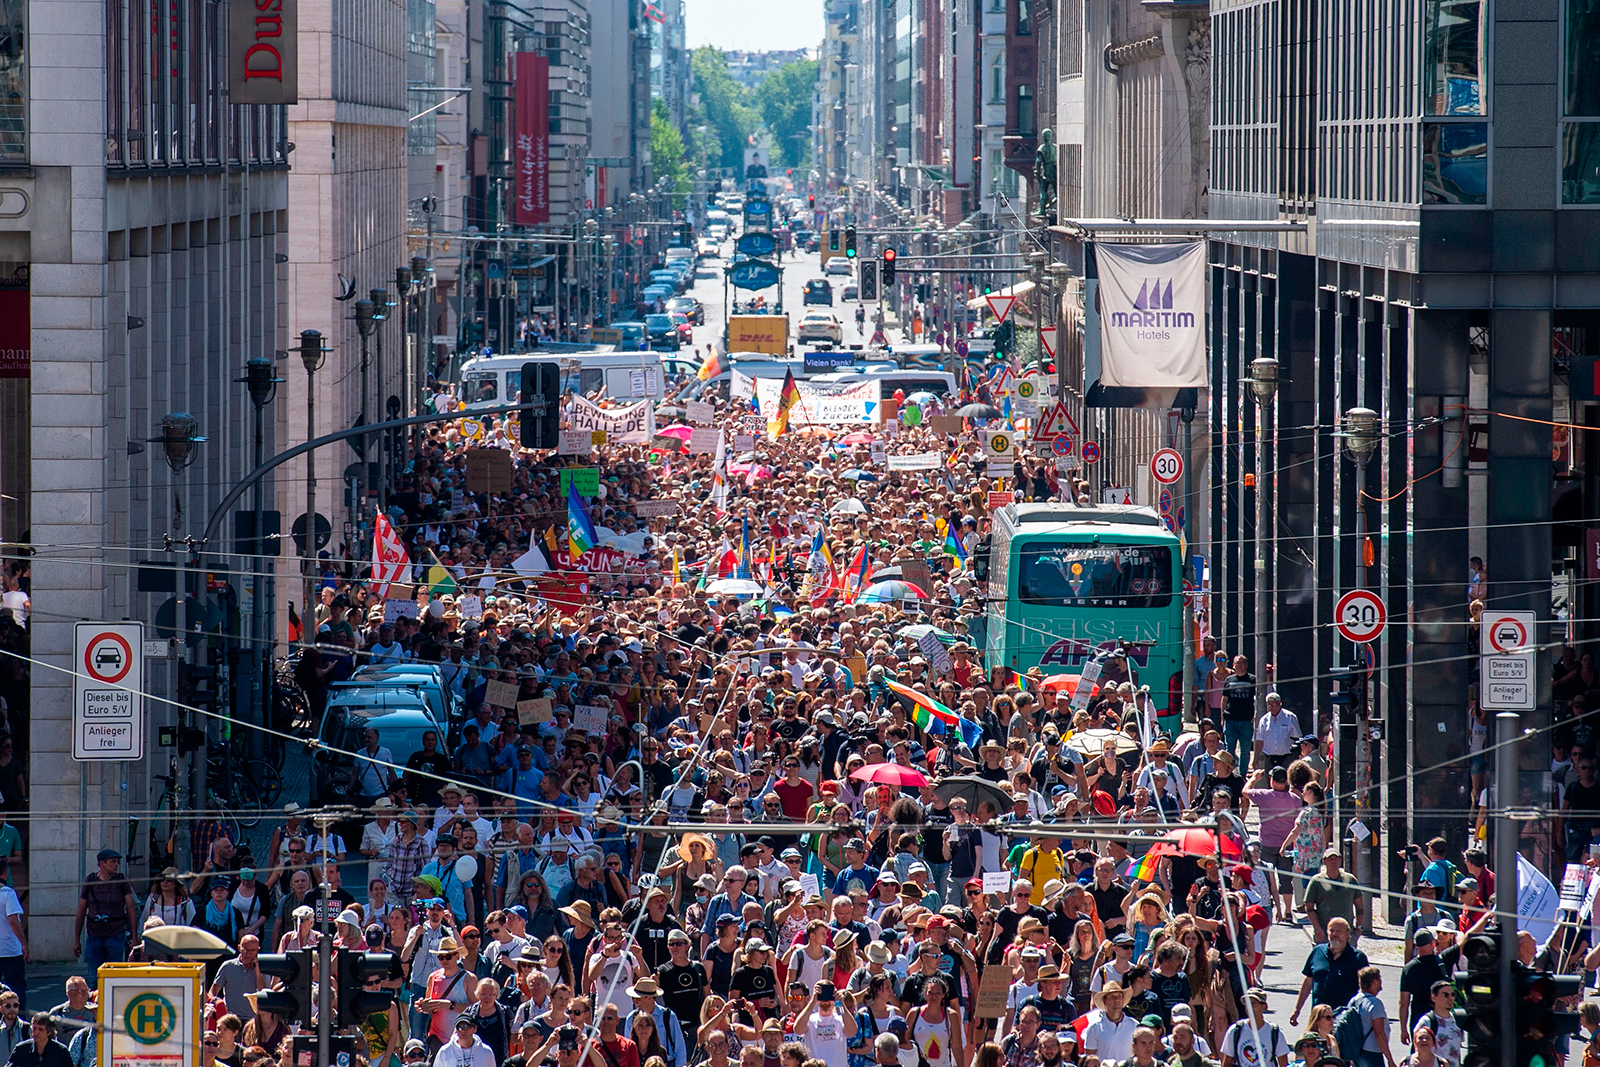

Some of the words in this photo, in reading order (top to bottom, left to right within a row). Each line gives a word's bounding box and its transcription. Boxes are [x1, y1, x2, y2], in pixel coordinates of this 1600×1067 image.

[1111, 311, 1195, 328] MARITIM
[740, 334, 774, 342] DHL
[1136, 330, 1171, 340] Hotels
[831, 359, 852, 367] Dank!
[574, 416, 646, 433] HALLE.DE
[1158, 461, 1176, 473] 30
[1346, 605, 1375, 627] 30
[1022, 617, 1168, 647] REISEN
[1492, 661, 1513, 669] Diesel
[1493, 686, 1523, 694] Anlieger
[87, 692, 114, 702] Diesel
[116, 692, 129, 701] bis
[88, 705, 109, 714] Euro
[112, 705, 127, 714] 5/V
[88, 726, 127, 737] Anlieger
[100, 738, 116, 747] frei
[137, 1004, 162, 1034] H
